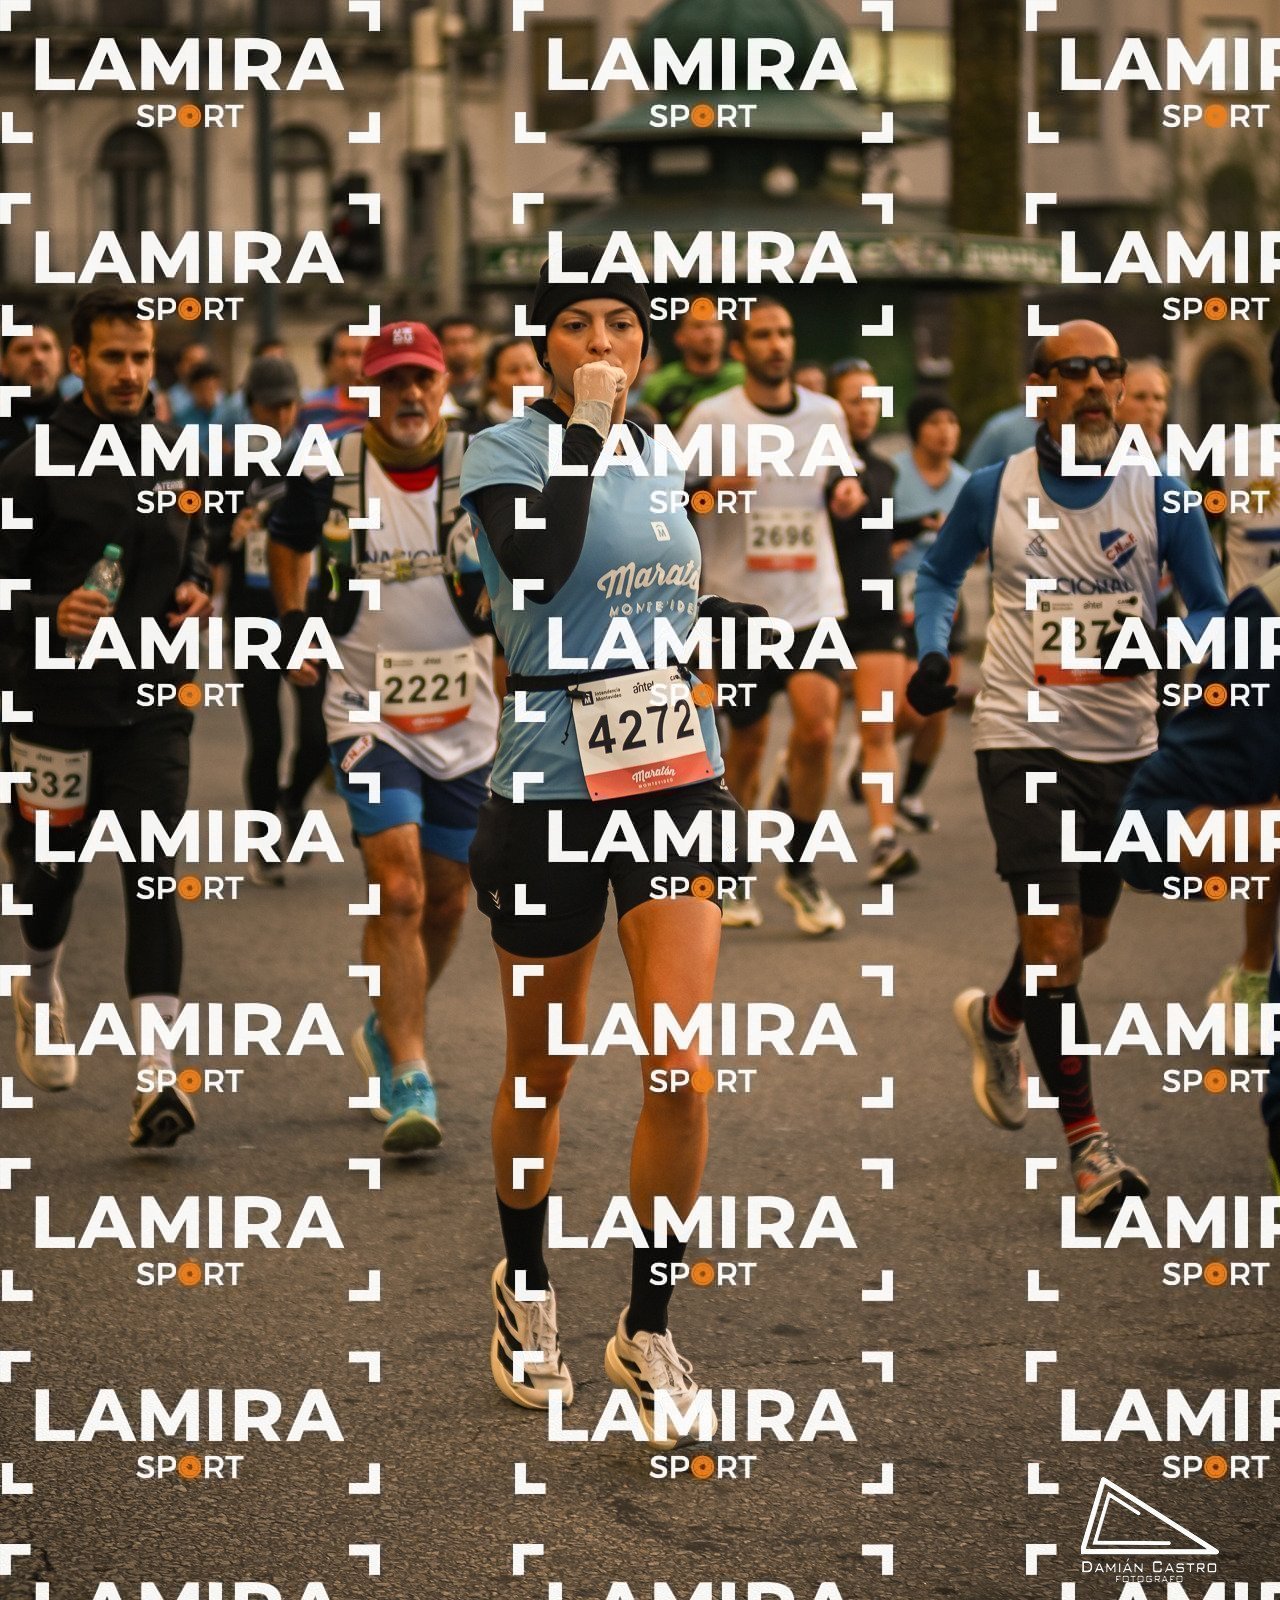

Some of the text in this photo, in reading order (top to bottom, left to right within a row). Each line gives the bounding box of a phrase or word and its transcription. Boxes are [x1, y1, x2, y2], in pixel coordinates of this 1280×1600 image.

[609, 599, 696, 618] MONTEIDE
[1041, 620, 1112, 652] 27
[384, 671, 467, 704] 2221
[588, 699, 695, 754] 4272
[13, 760, 80, 798] 532
[632, 765, 677, 783] Maratón
[638, 777, 674, 789] MONTEVIDEO
